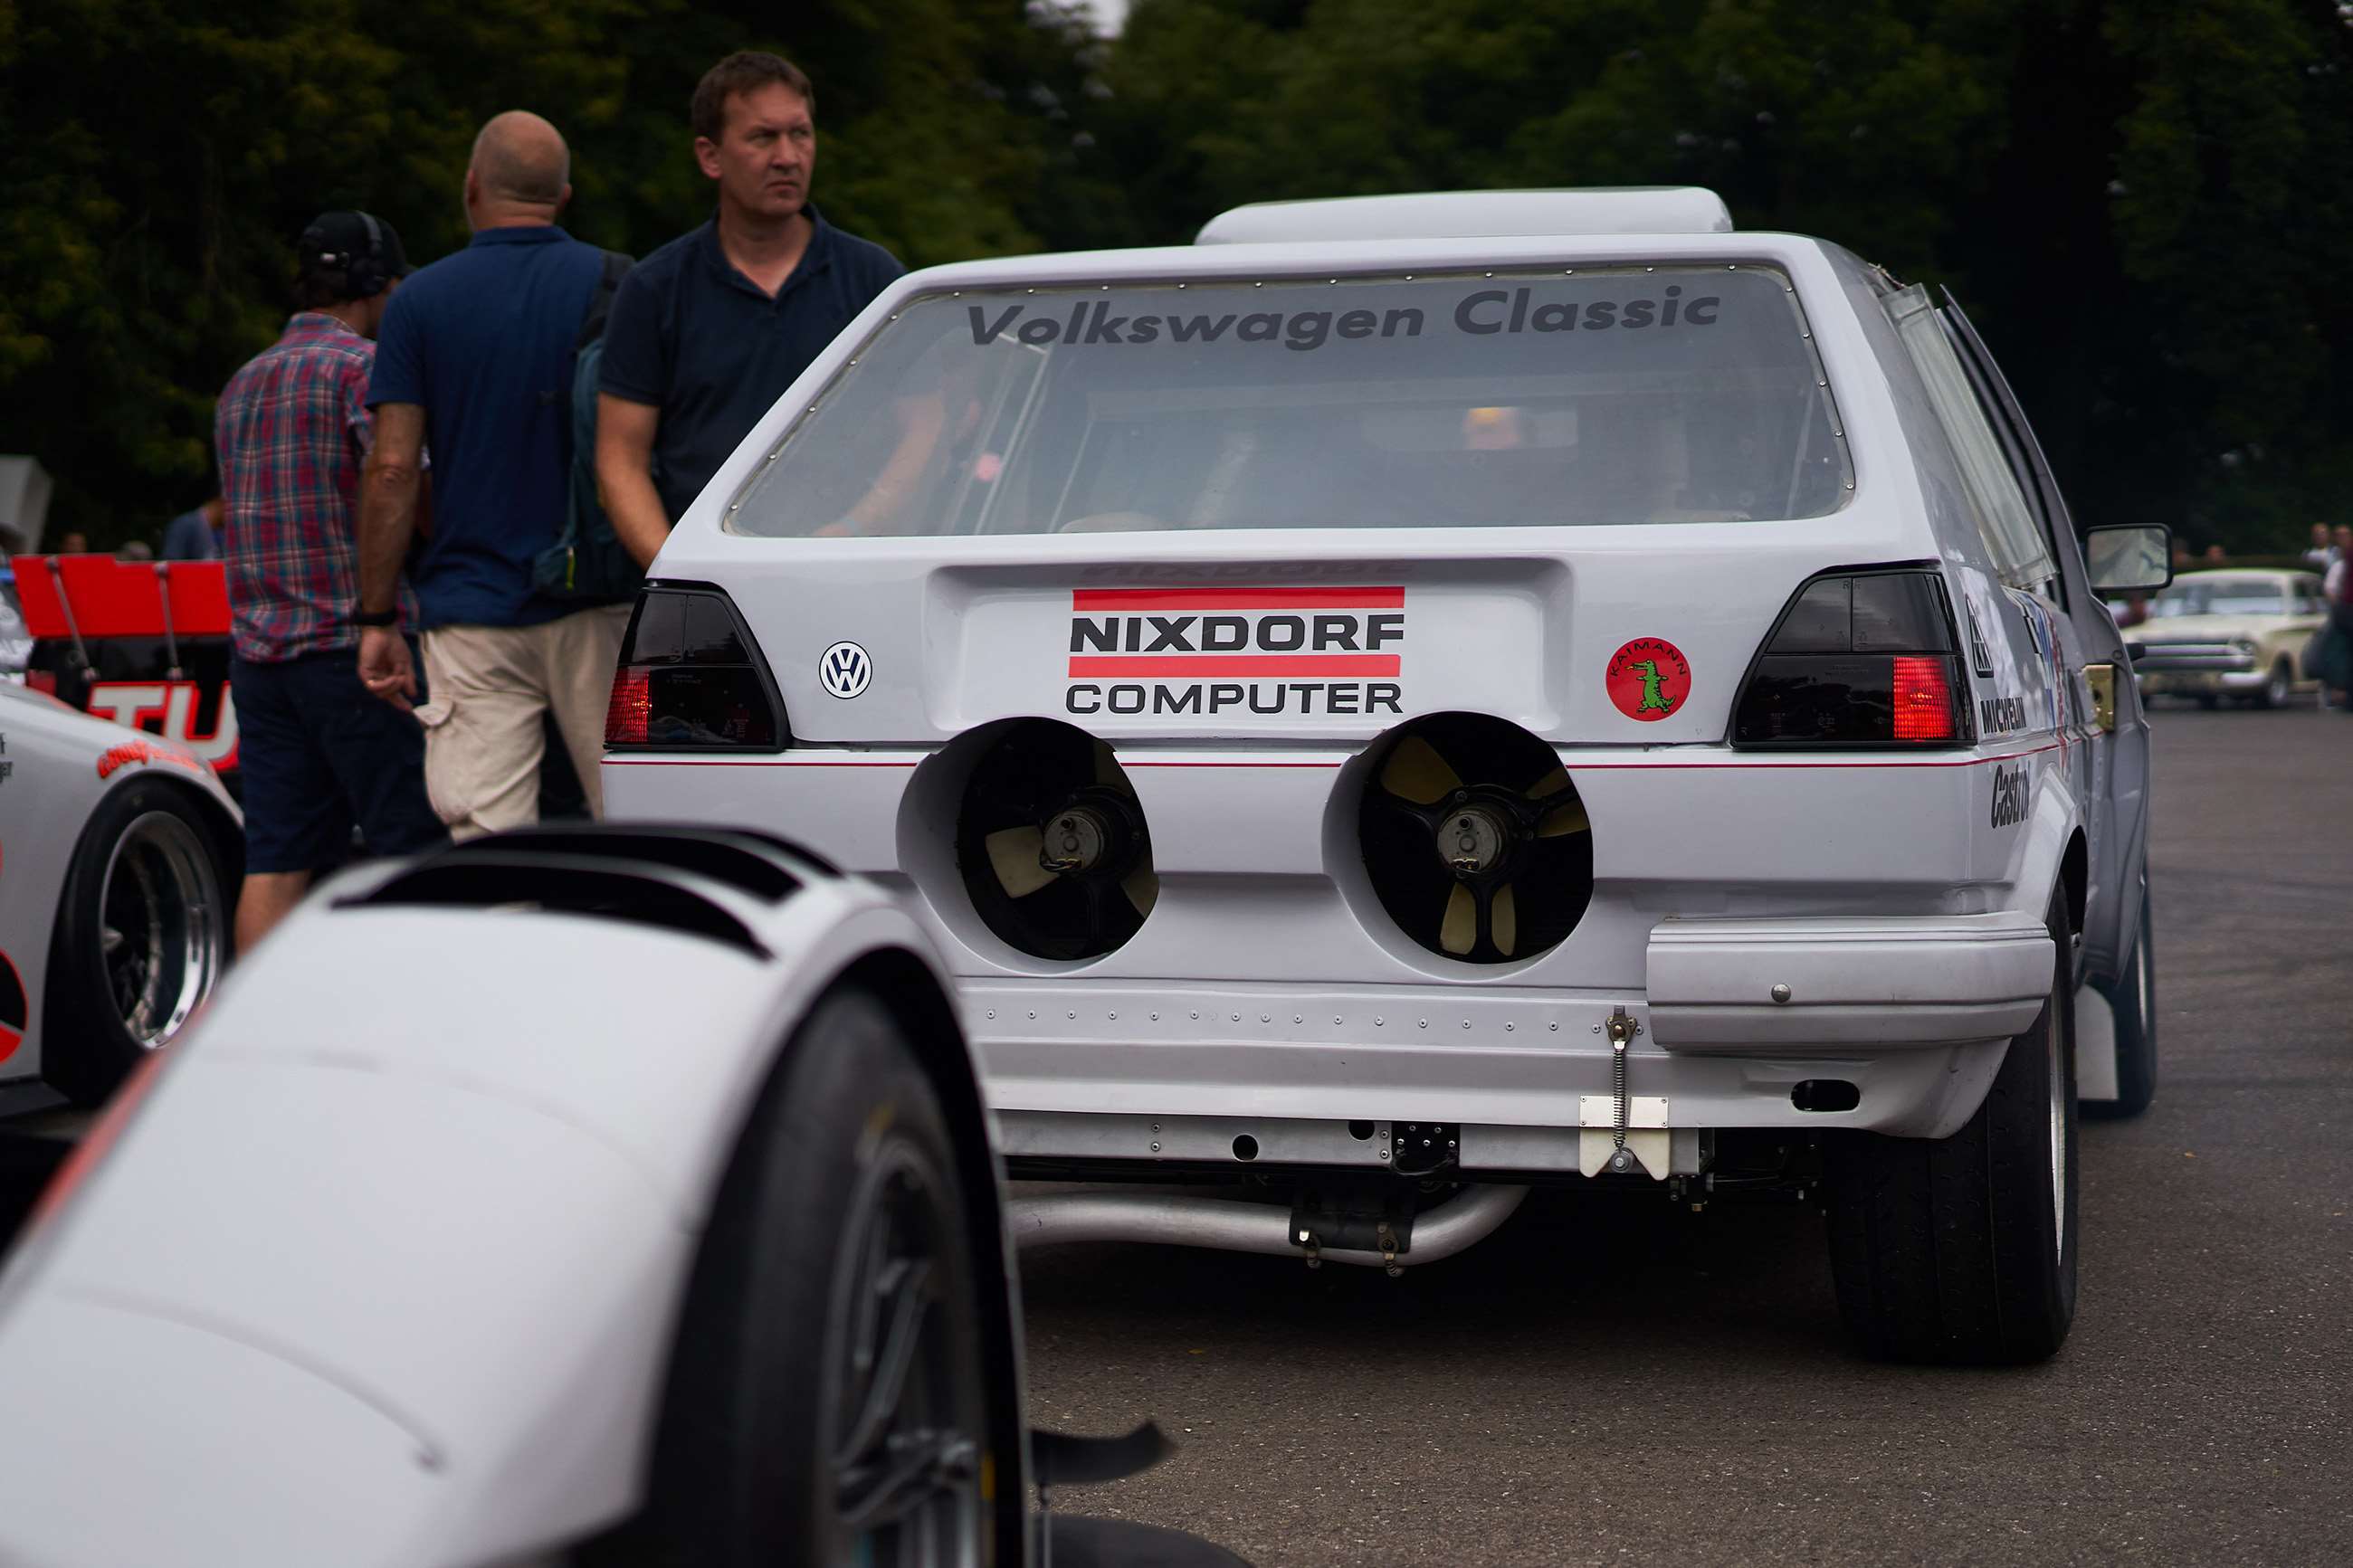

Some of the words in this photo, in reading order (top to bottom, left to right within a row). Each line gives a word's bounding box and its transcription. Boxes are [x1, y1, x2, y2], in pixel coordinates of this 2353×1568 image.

[968, 300, 1424, 351] Volkswagen
[1454, 285, 1720, 335] Classic
[1070, 614, 1405, 652] NIXDORF
[1611, 641, 1686, 677] KAIMANN
[1065, 683, 1404, 714] COMPUTER
[1980, 697, 2026, 734] MICHELIN
[1991, 760, 2030, 829] Castrol
